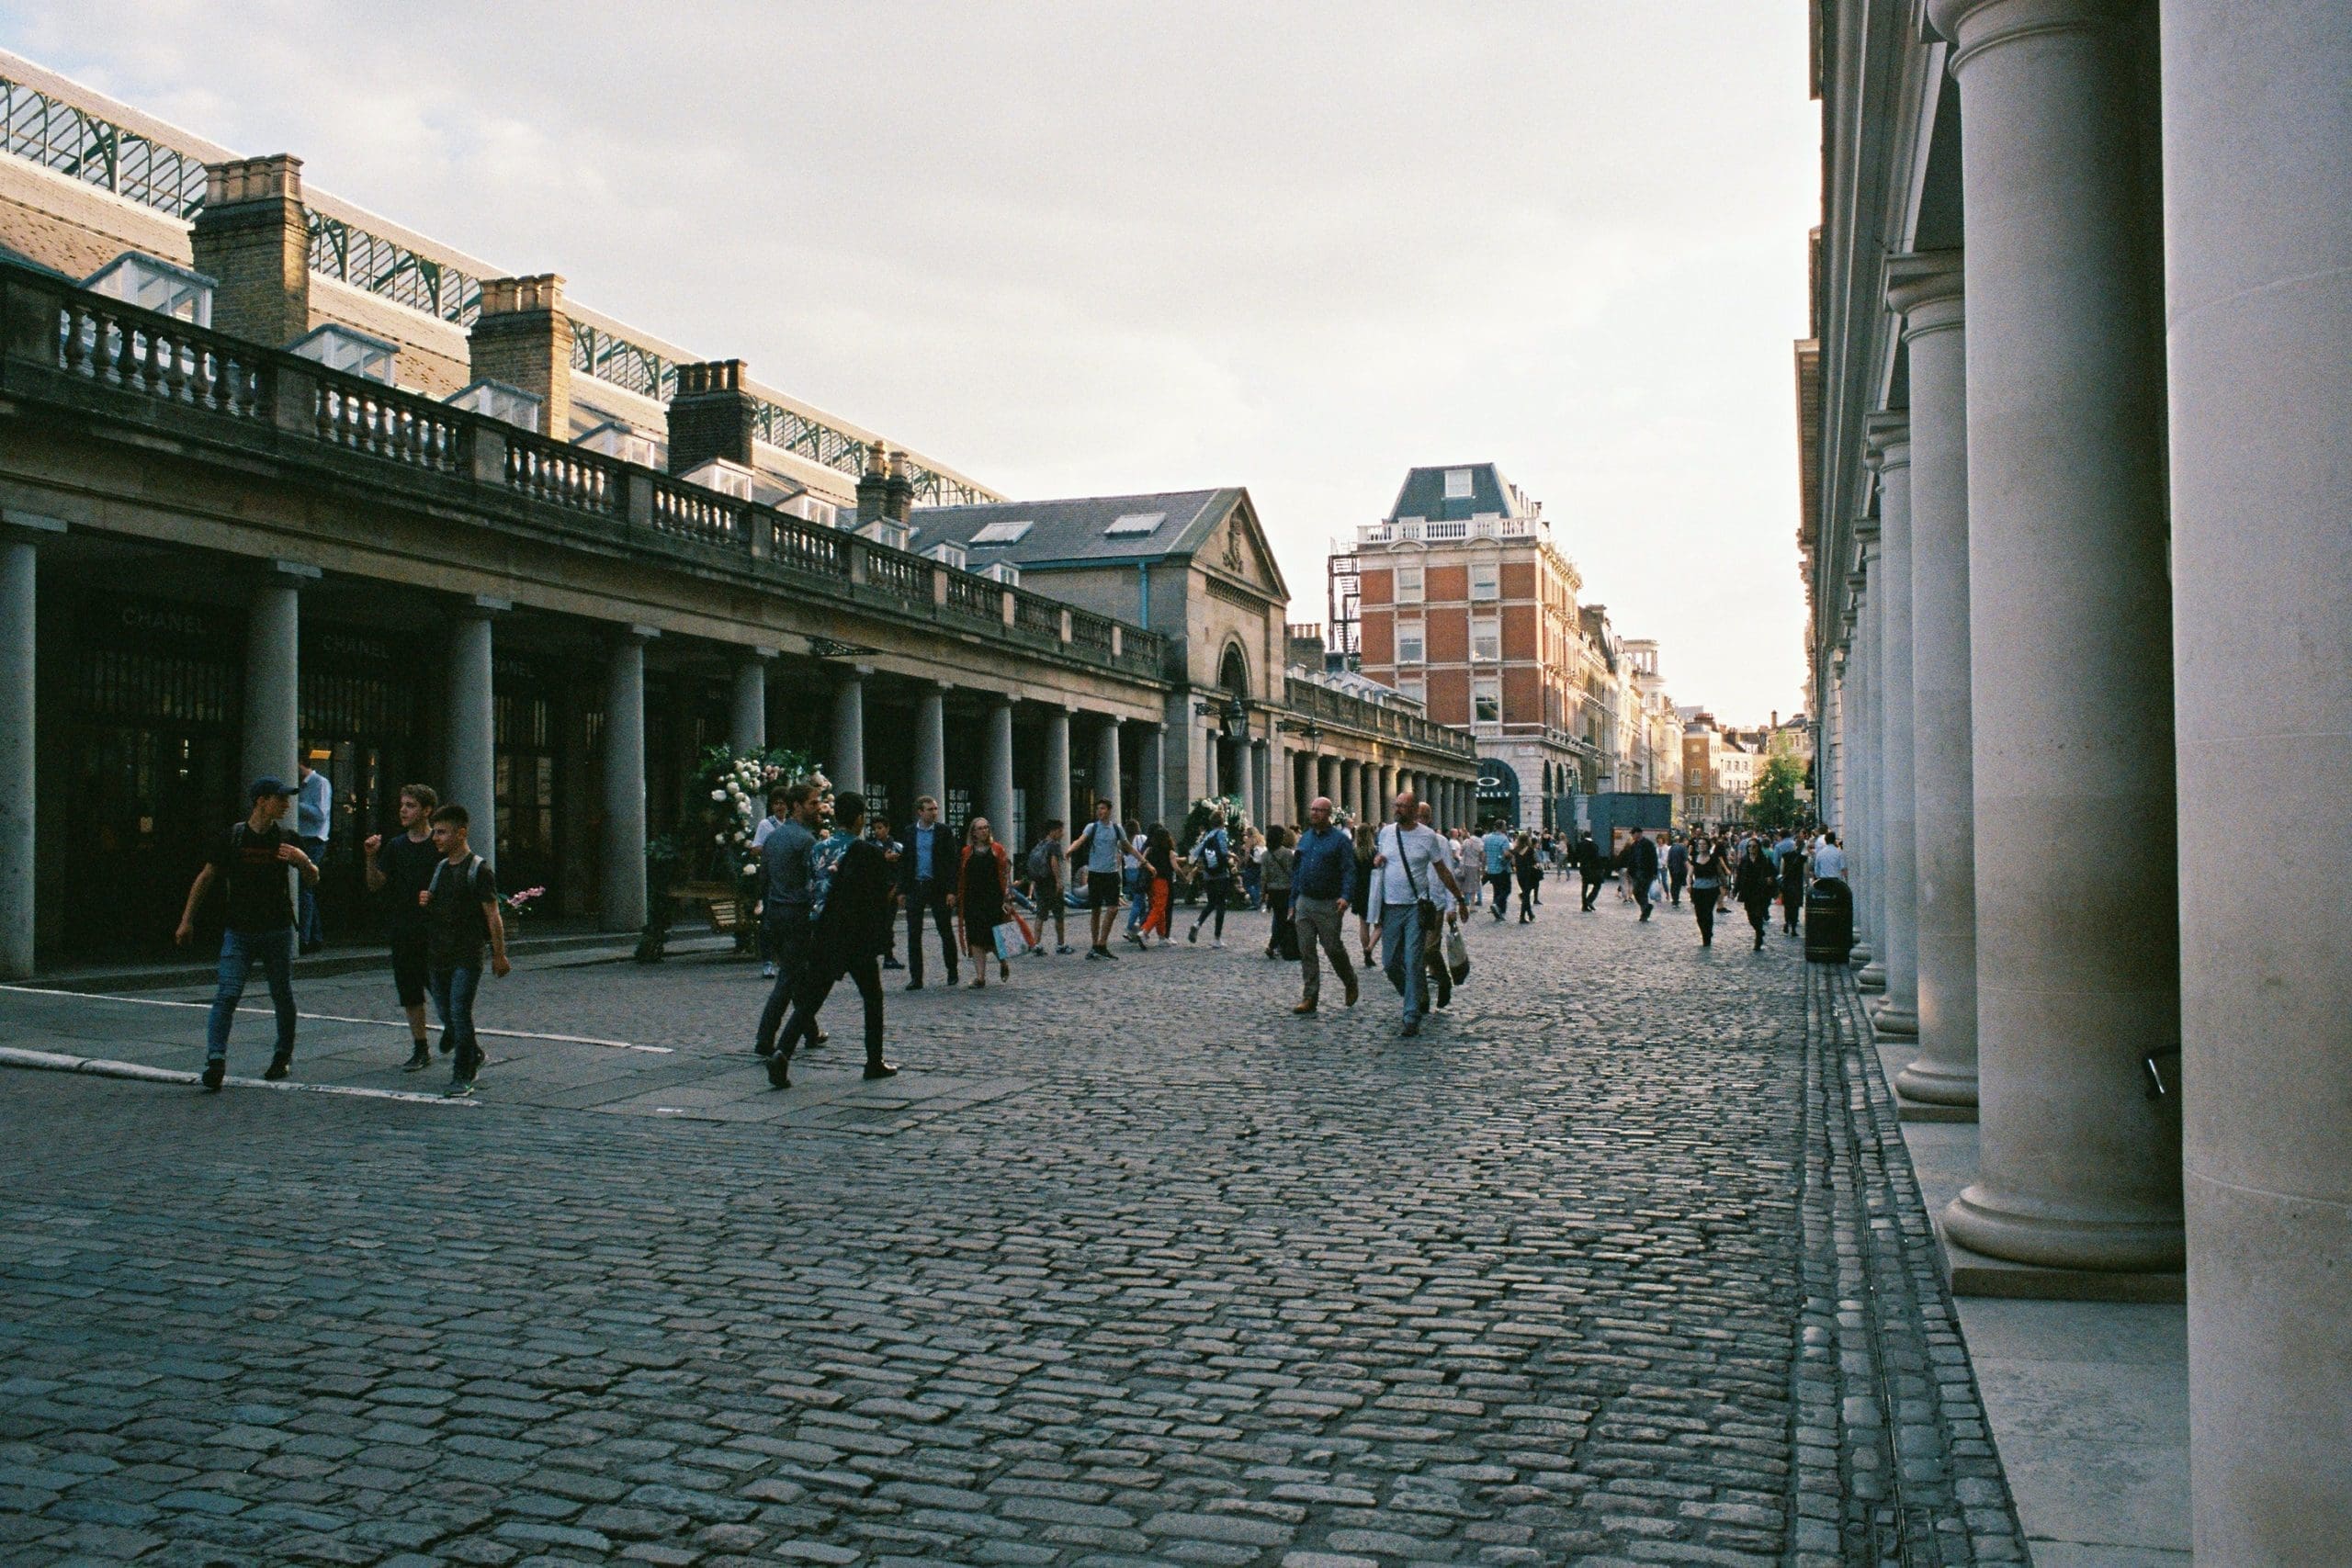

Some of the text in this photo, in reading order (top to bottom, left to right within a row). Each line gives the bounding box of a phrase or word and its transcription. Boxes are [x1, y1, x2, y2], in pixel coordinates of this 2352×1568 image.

[121, 607, 207, 634] CHANEL
[322, 635, 390, 659] CHANEL
[493, 660, 536, 678] ANEL
